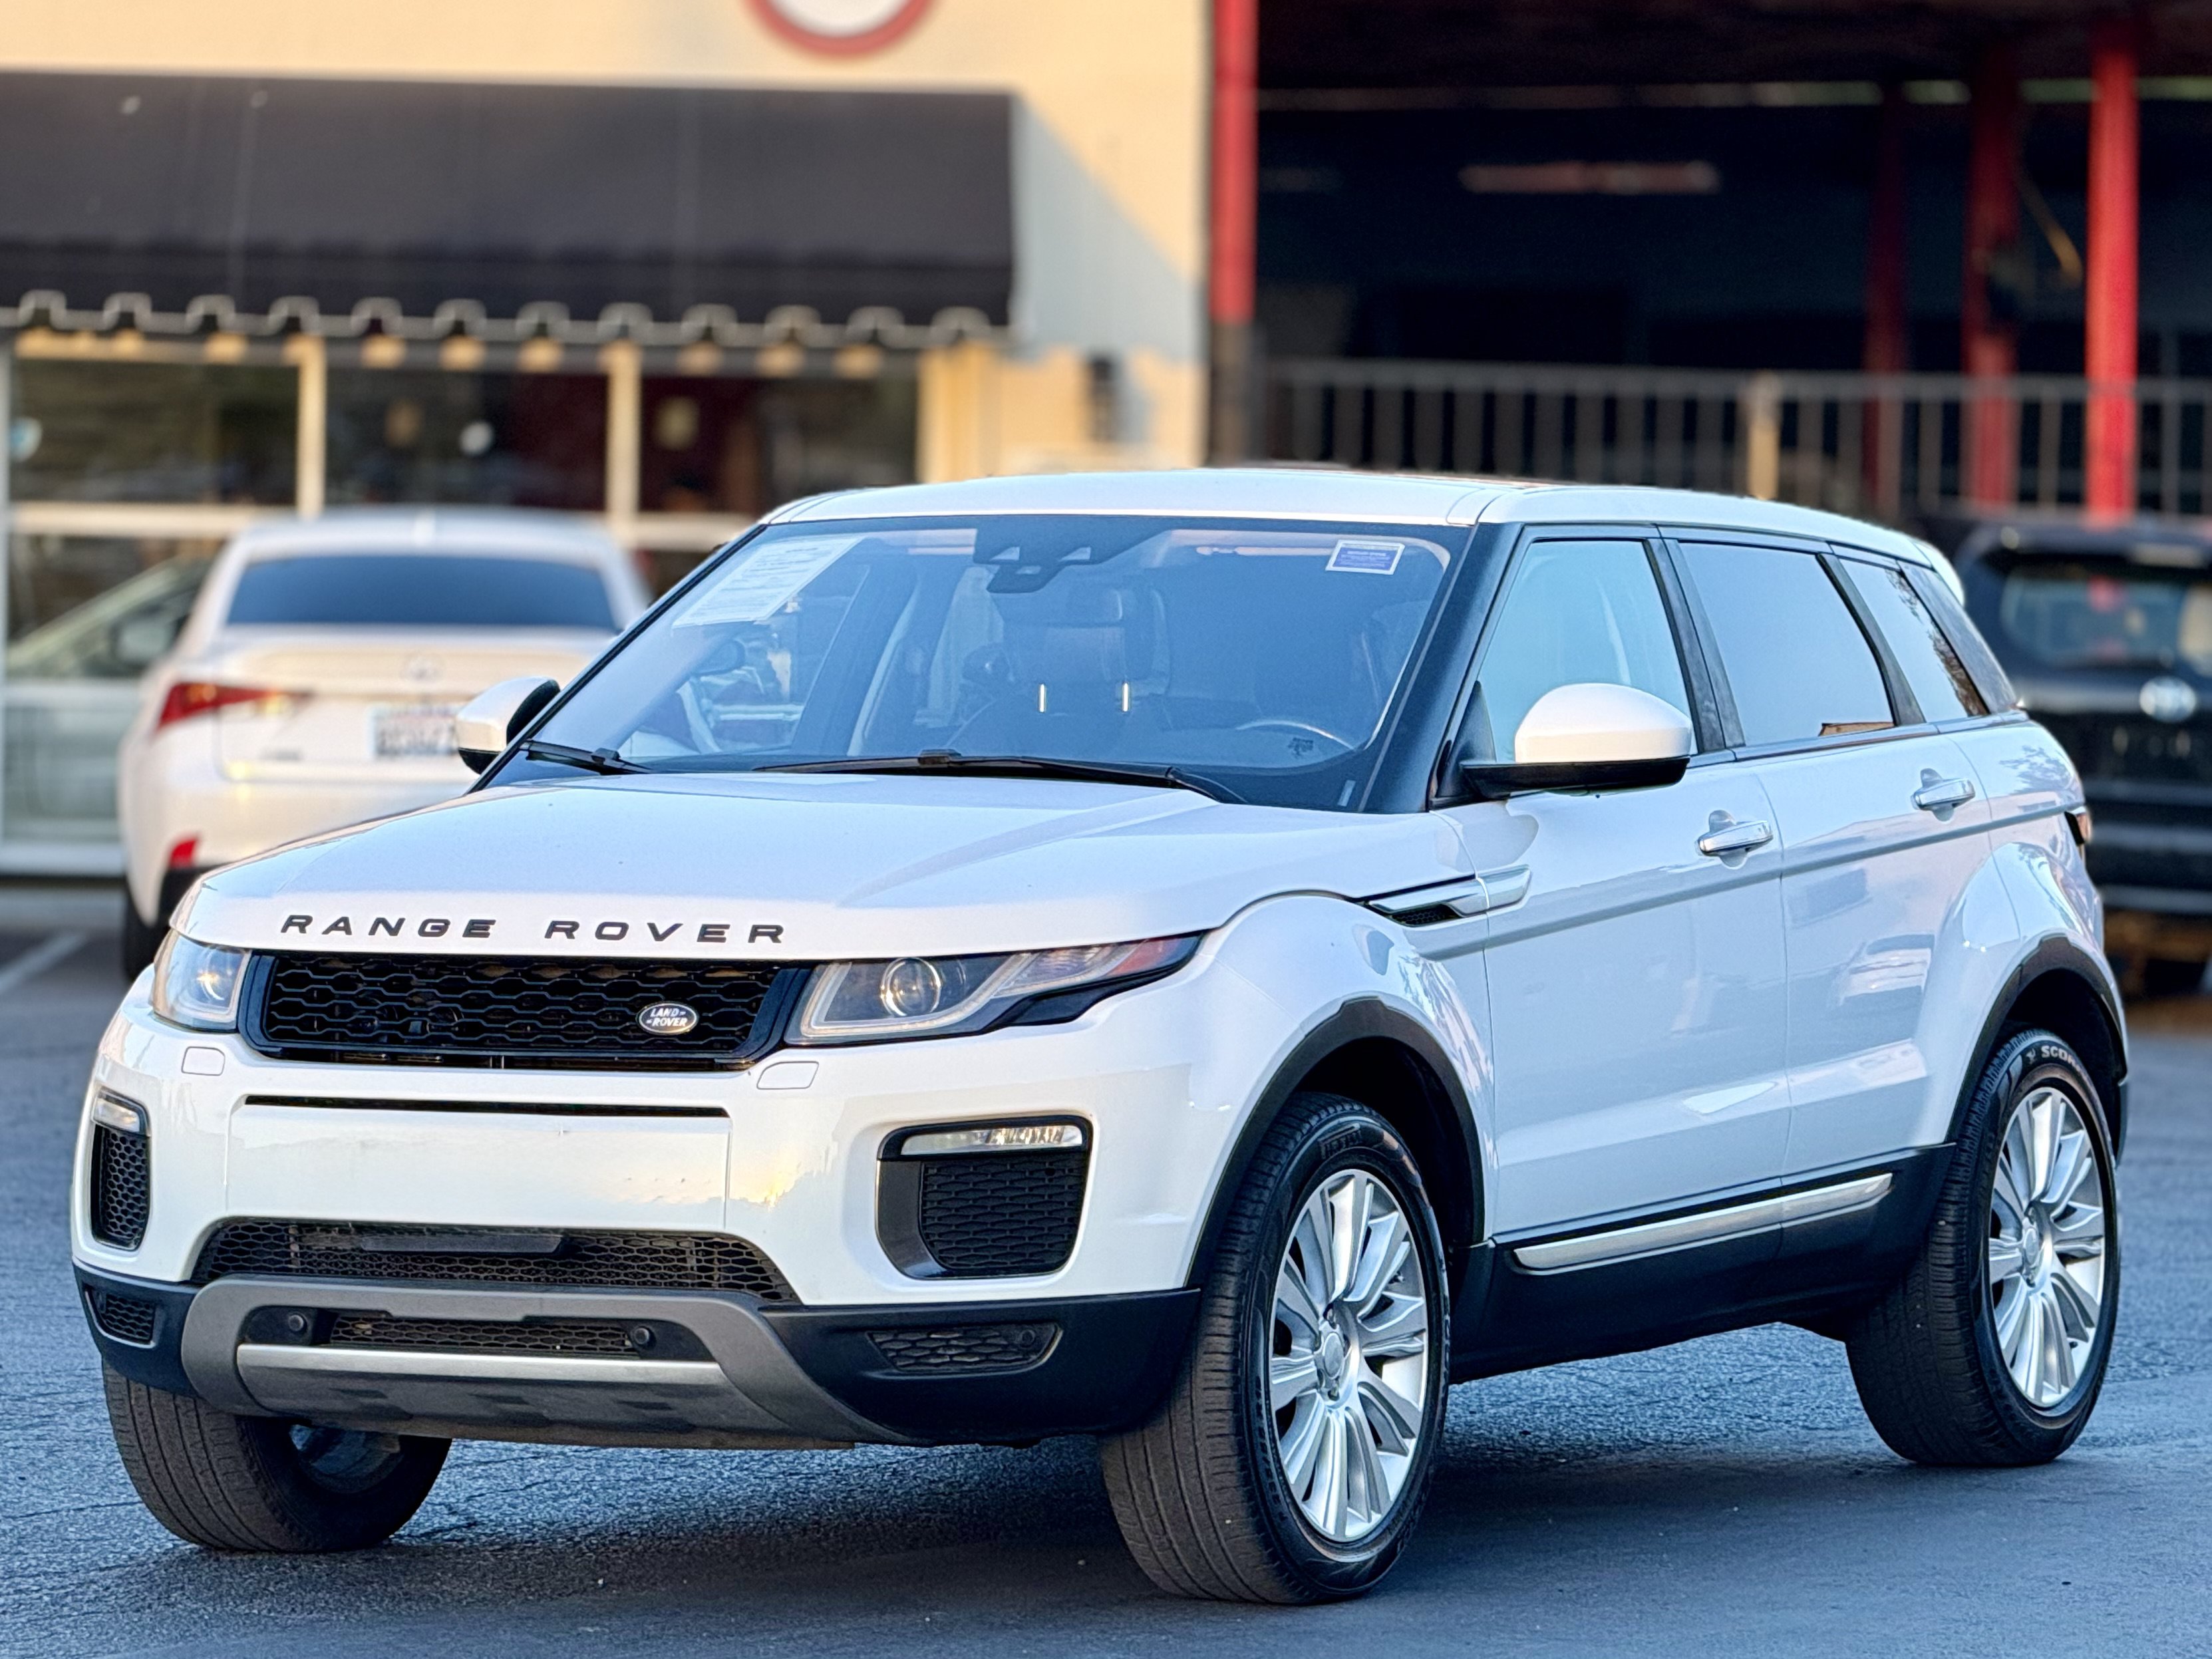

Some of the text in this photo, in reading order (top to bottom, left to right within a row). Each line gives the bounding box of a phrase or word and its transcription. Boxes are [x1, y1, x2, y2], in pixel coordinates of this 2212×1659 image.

[281, 915, 784, 943] RANGE ROVER
[650, 1008, 680, 1017] LAND
[651, 1017, 688, 1026] ROVER
[2040, 1045, 2081, 1072] SCOR
